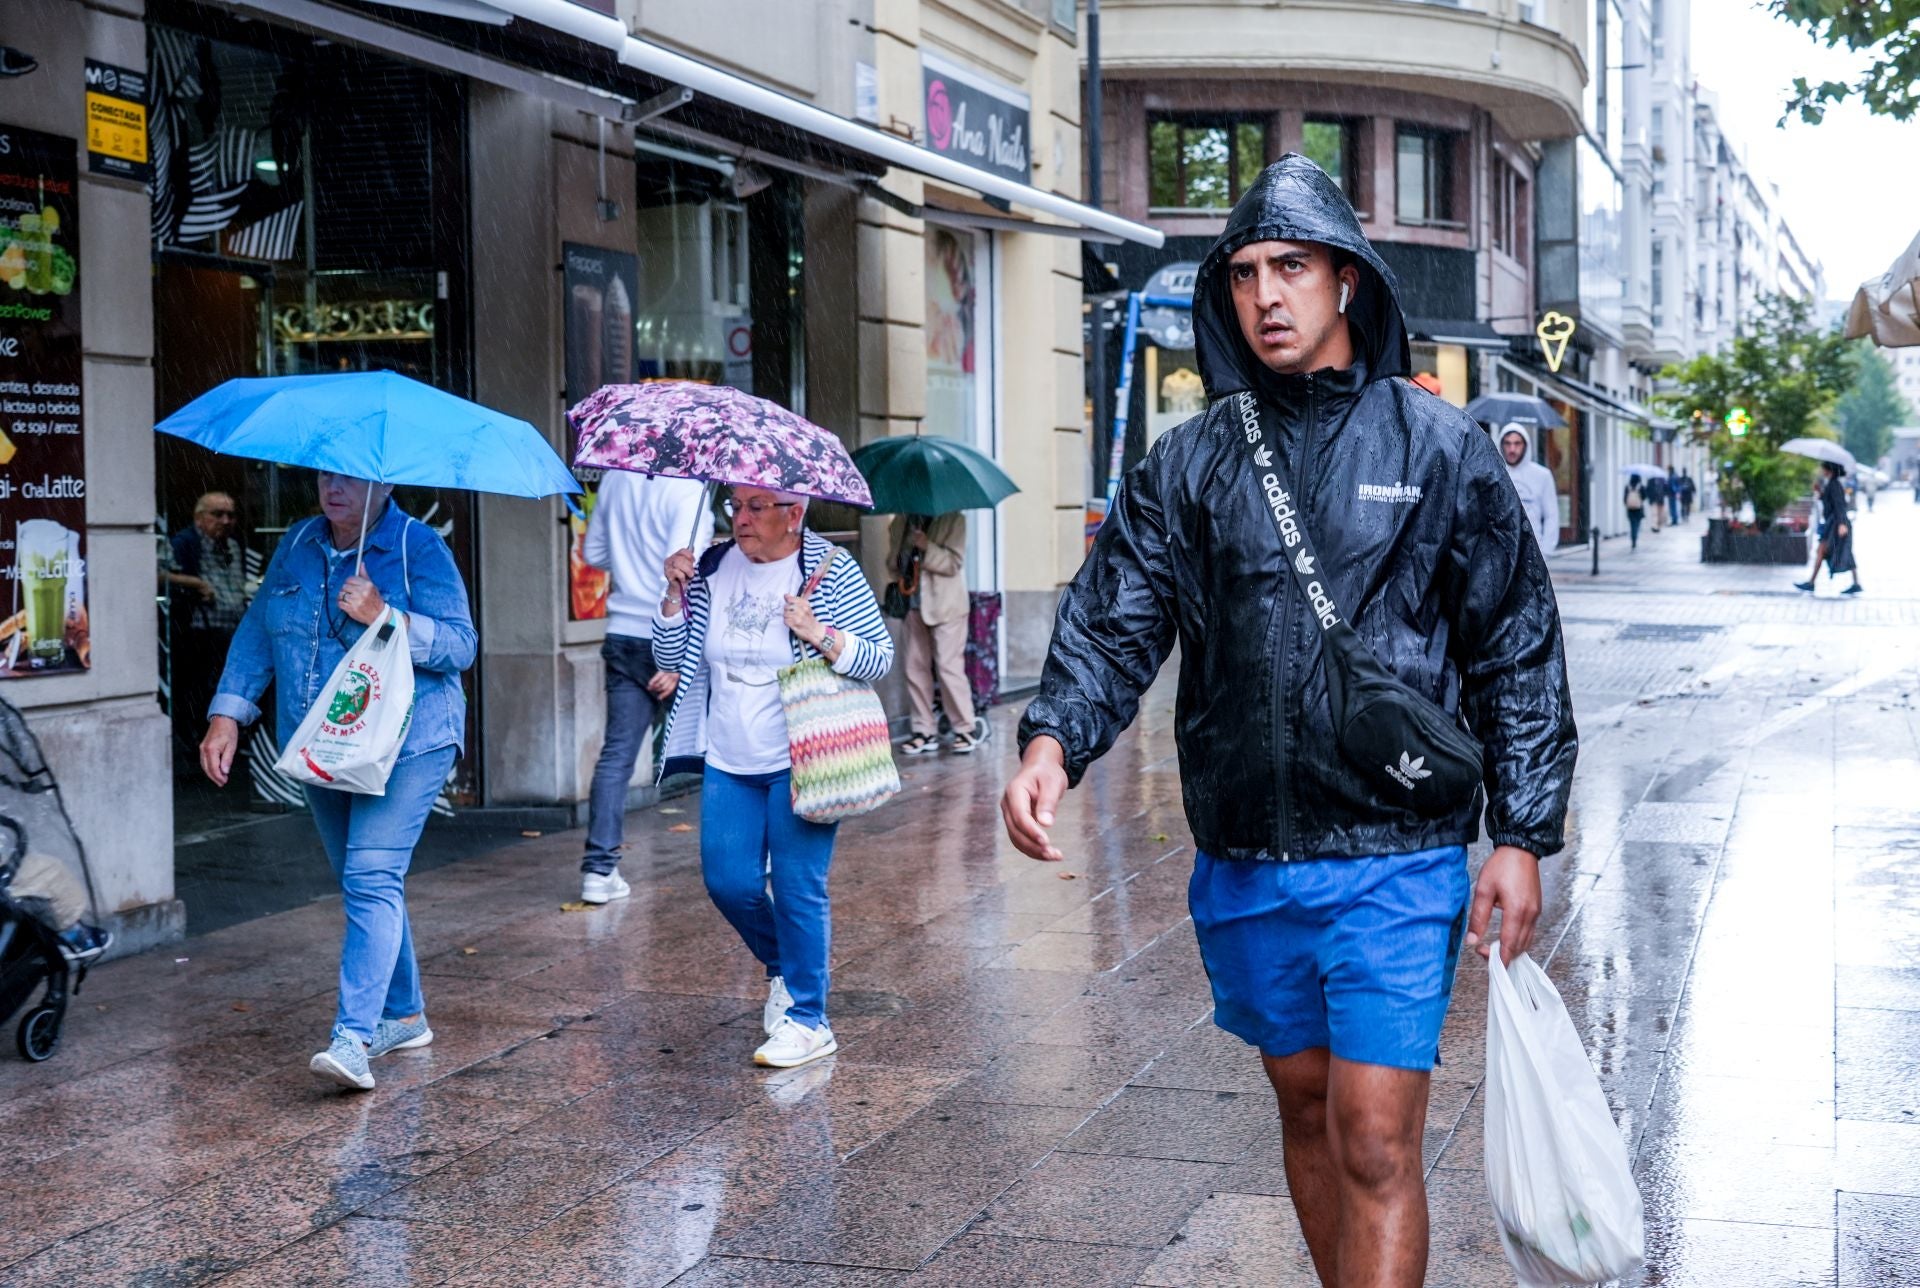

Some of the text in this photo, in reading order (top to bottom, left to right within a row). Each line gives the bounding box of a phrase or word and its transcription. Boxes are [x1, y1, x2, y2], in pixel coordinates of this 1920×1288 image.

[952, 101, 1027, 173] Ana Nails
[32, 381, 80, 397] desnatada
[3, 399, 81, 416] lactosa o bebida
[12, 420, 27, 434] de
[28, 420, 47, 436] soja
[1358, 481, 1422, 498] IRONMAN
[1262, 472, 1302, 548] adidas
[1385, 764, 1416, 791] adidas
